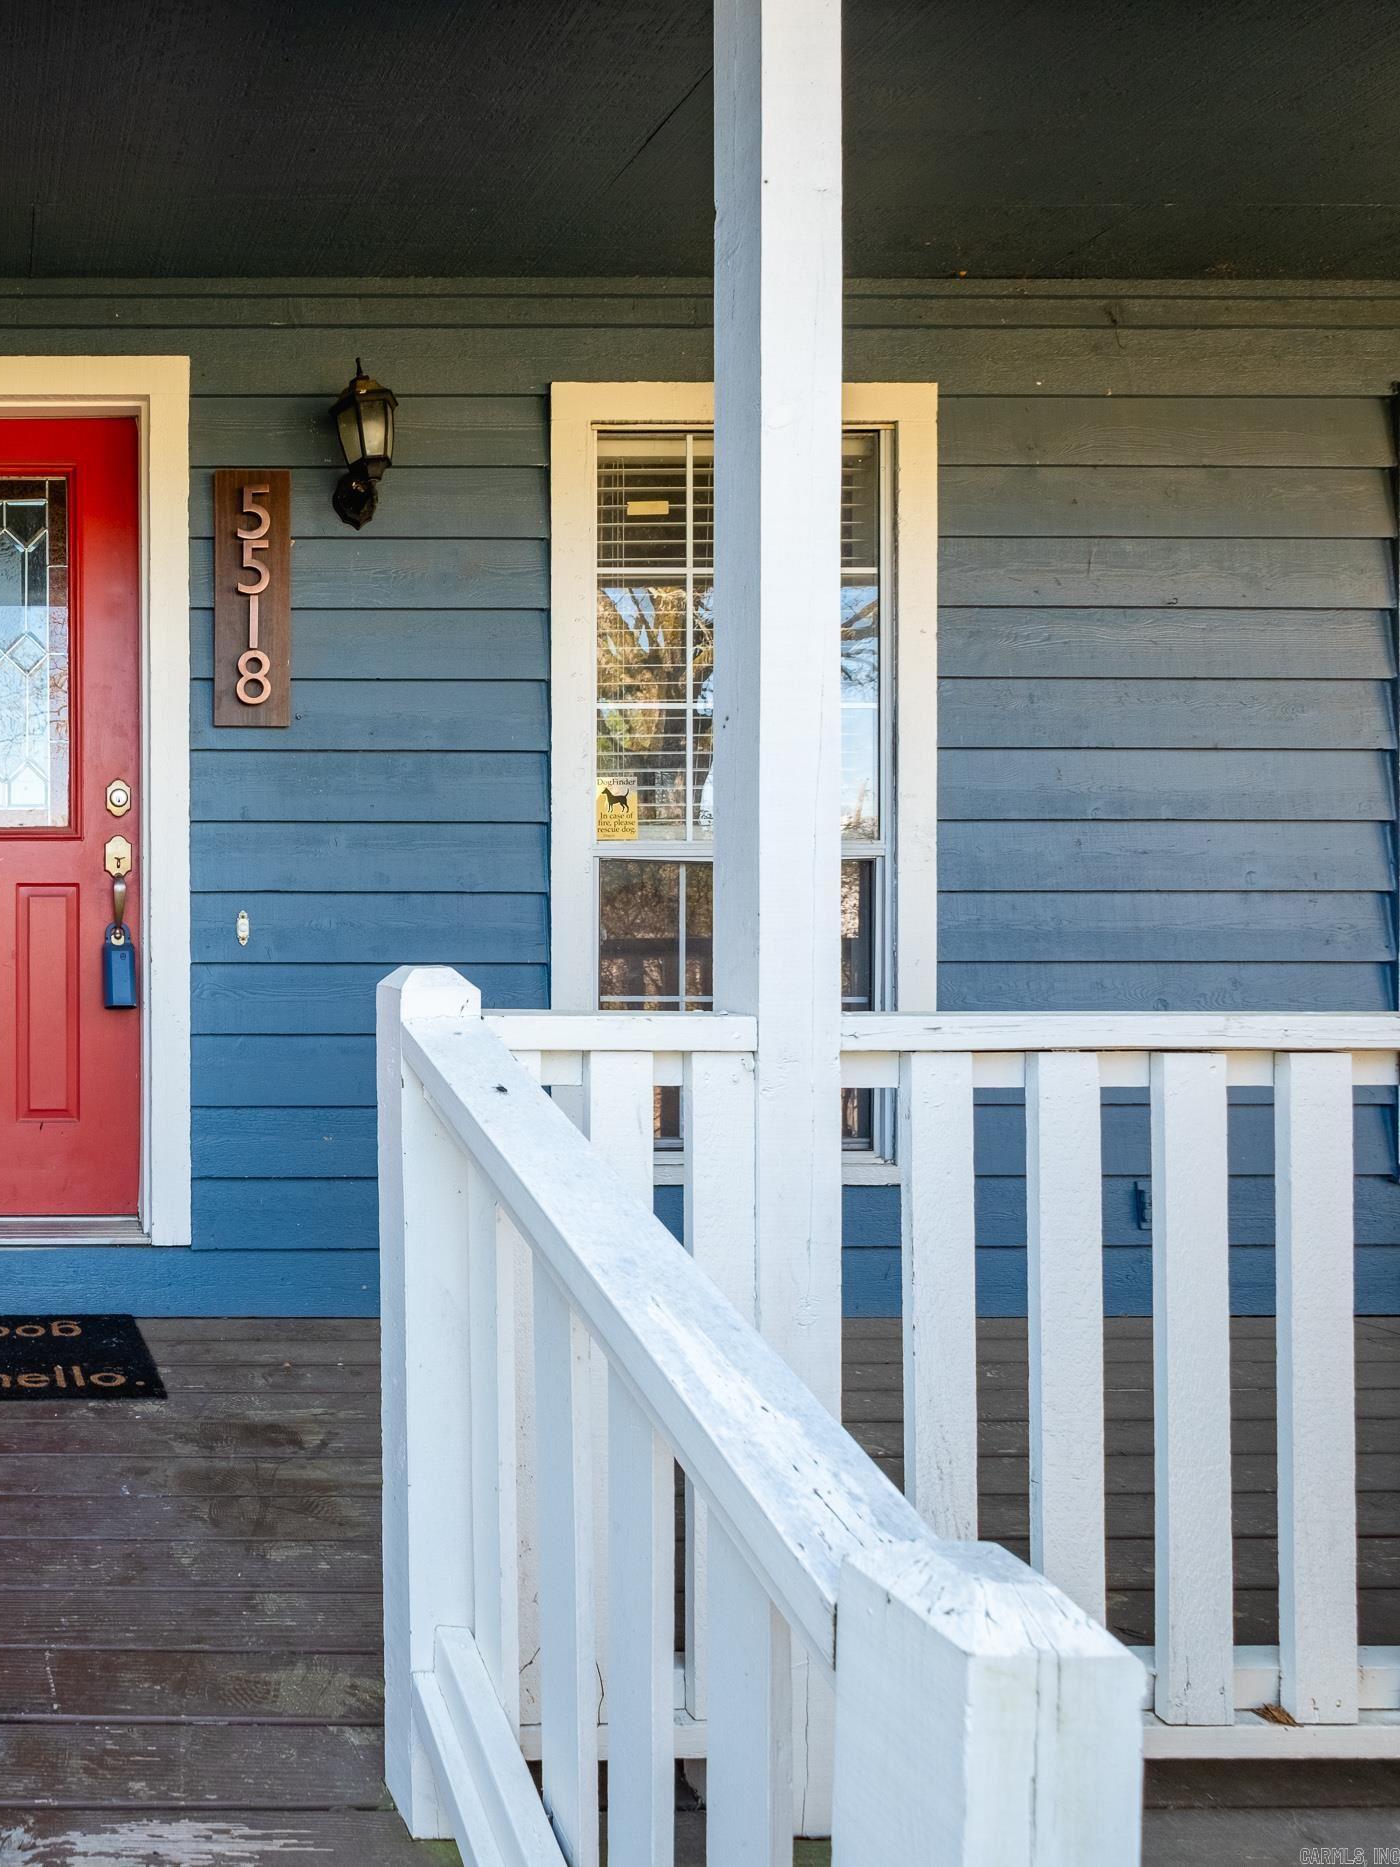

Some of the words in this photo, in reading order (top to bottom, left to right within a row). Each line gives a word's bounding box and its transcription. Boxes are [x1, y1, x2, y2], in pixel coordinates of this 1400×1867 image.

[236, 484, 272, 705] 5518
[597, 778, 636, 787] DogFinder
[613, 820, 636, 828] please
